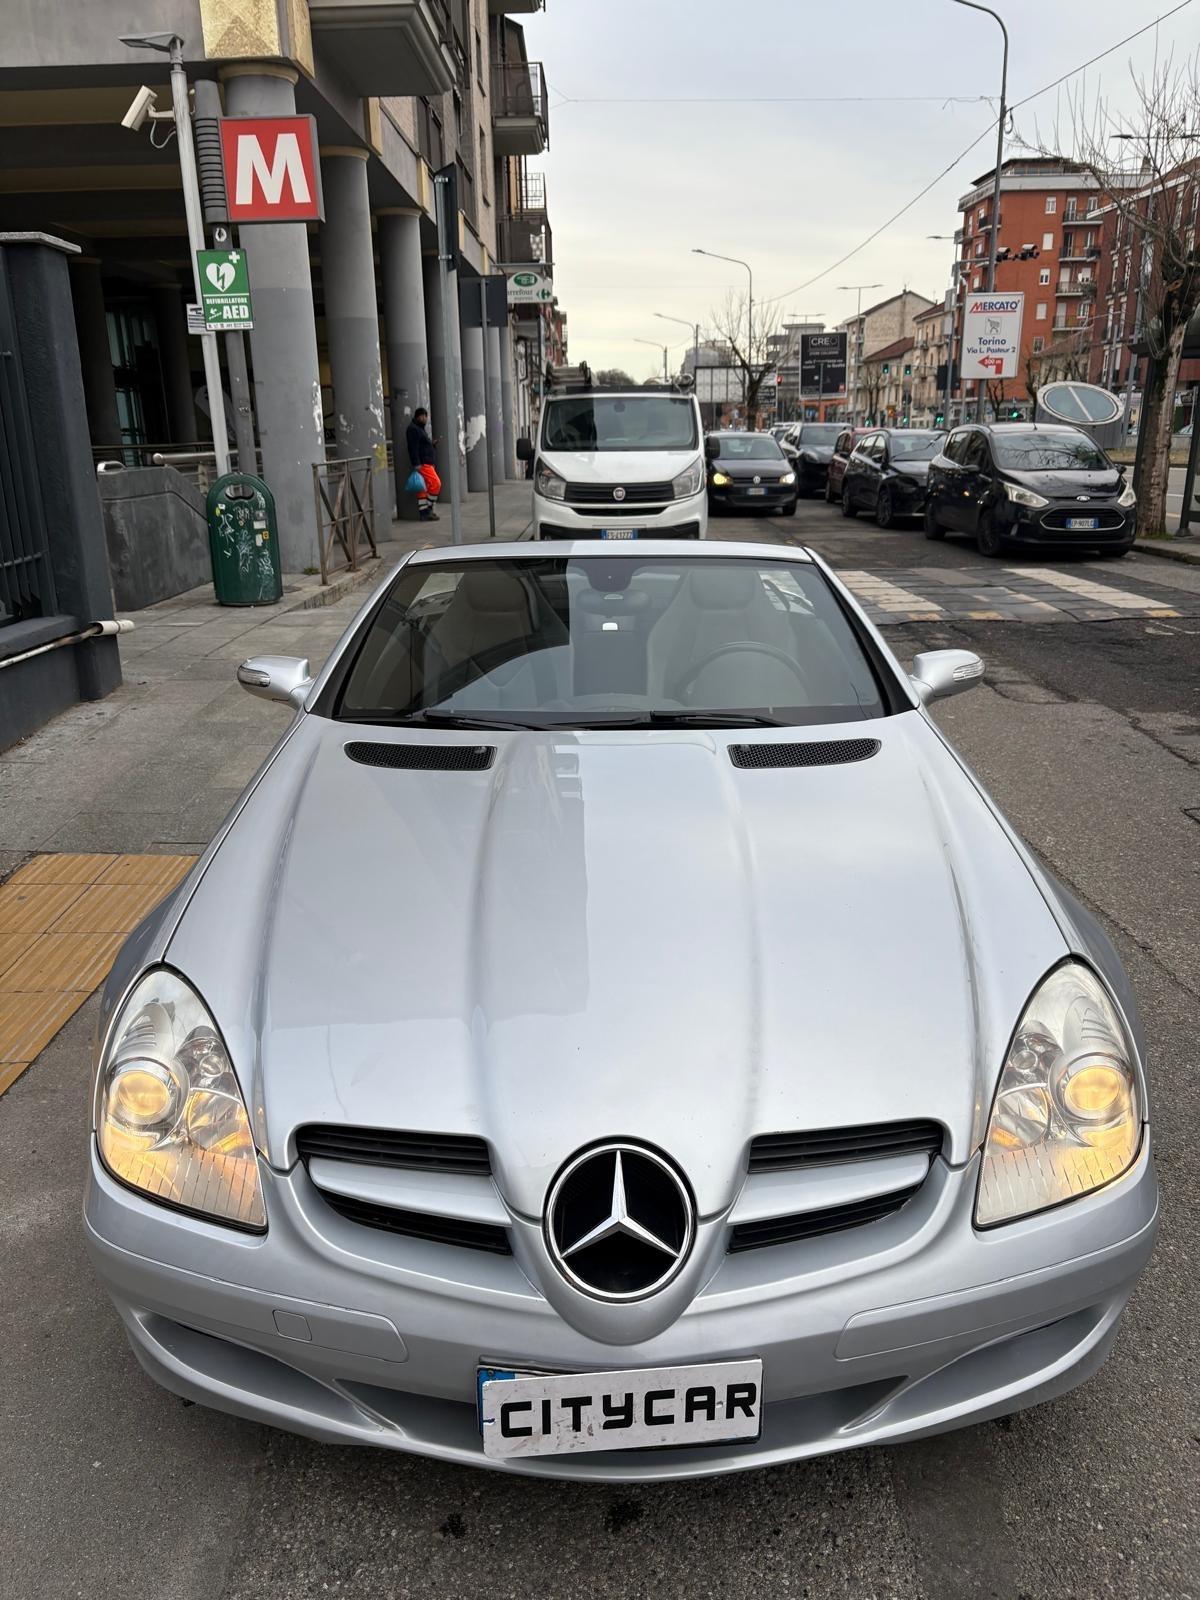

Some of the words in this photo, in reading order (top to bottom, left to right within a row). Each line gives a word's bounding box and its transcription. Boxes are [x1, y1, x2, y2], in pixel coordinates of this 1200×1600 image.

[236, 133, 312, 205] M
[206, 297, 248, 305] DEFIBRILLATORE
[222, 305, 250, 319] AED
[810, 337, 838, 346] CREO
[978, 336, 1007, 345] Torino
[500, 1383, 757, 1439] CITYCAR
